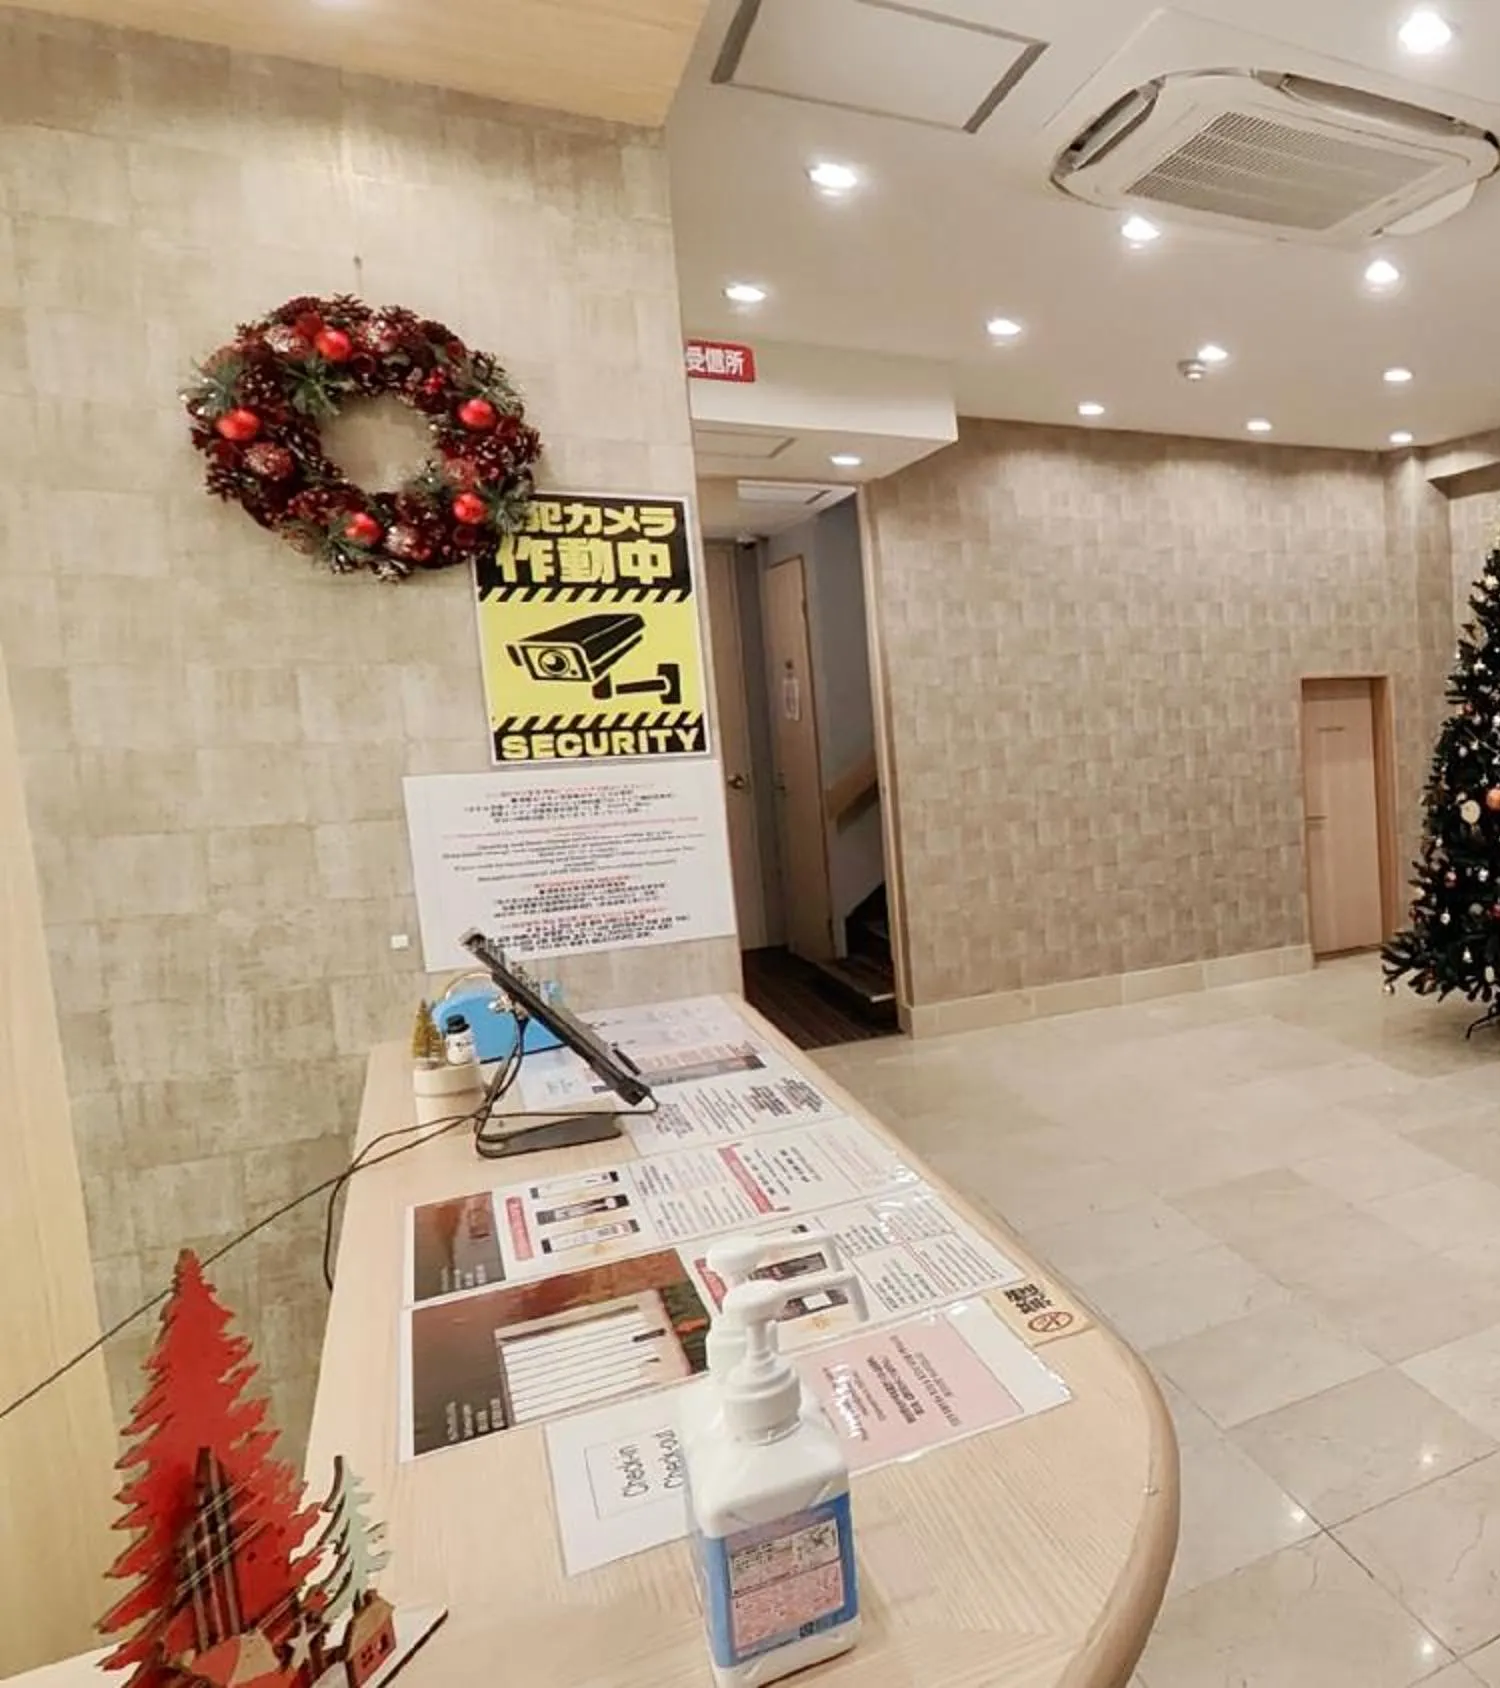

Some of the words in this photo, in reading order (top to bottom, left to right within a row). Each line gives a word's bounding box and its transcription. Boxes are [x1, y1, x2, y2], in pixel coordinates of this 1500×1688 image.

[524, 501, 676, 537] 犯カメラ
[495, 533, 673, 585] 作動中
[501, 727, 699, 760] SECURITY
